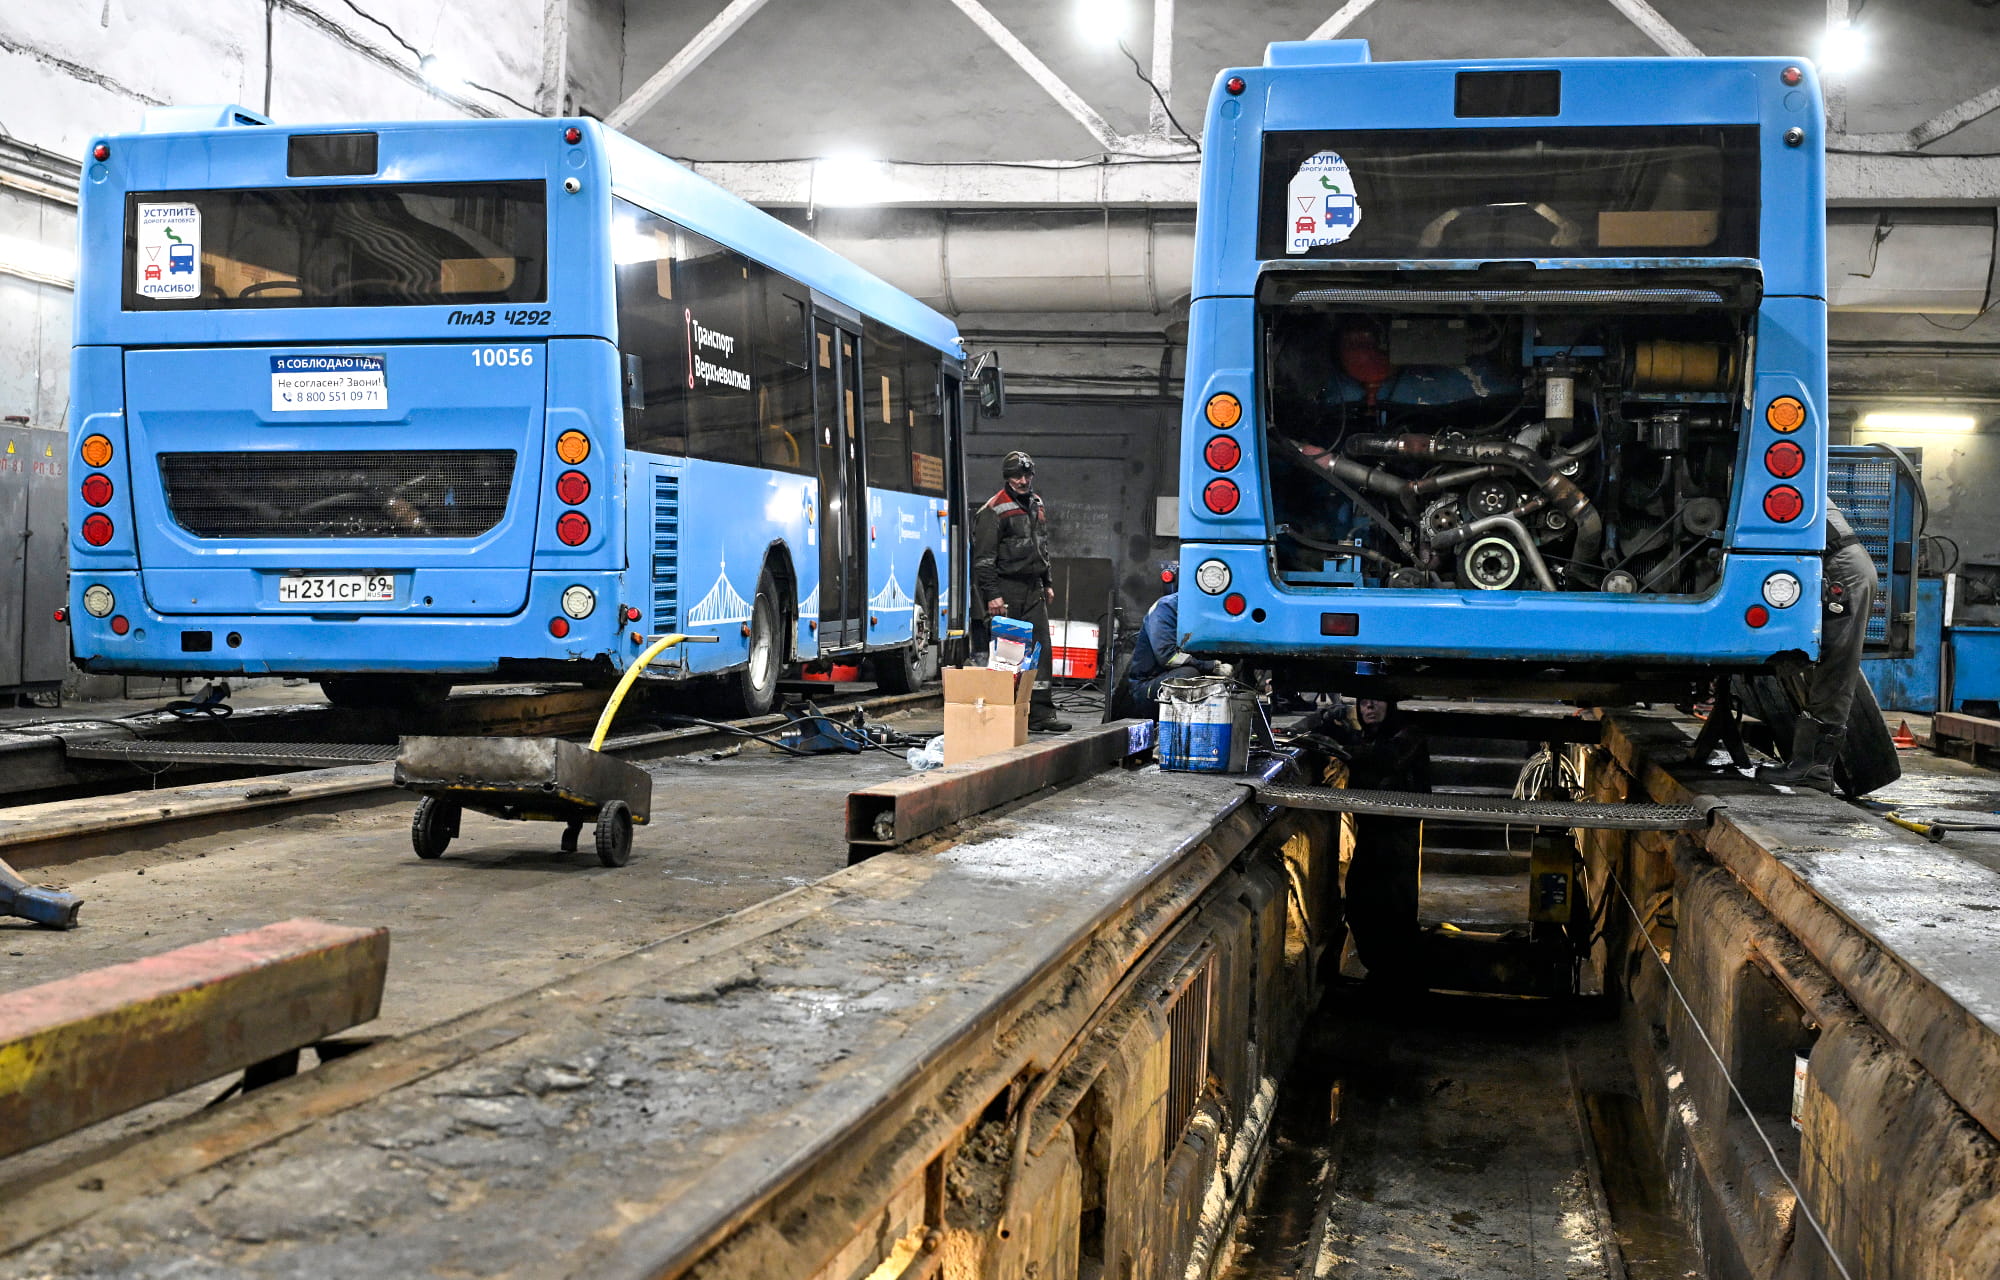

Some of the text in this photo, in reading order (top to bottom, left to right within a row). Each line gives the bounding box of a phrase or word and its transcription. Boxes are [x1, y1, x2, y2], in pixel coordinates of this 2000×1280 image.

[144, 208, 196, 217] УСТУПИТЕ
[144, 284, 195, 293] СПАСИБО!
[504, 310, 552, 325] 4292
[692, 319, 734, 359] Транспорт
[277, 359, 285, 369] Я
[286, 358, 354, 370] СОБЛЮДАЮ
[471, 348, 533, 367] 10056
[694, 354, 751, 391] Верхневолжья
[278, 377, 381, 388] Не согласен? Звони!
[297, 391, 378, 402] 8 800 551 09 71
[368, 576, 387, 591] 69
